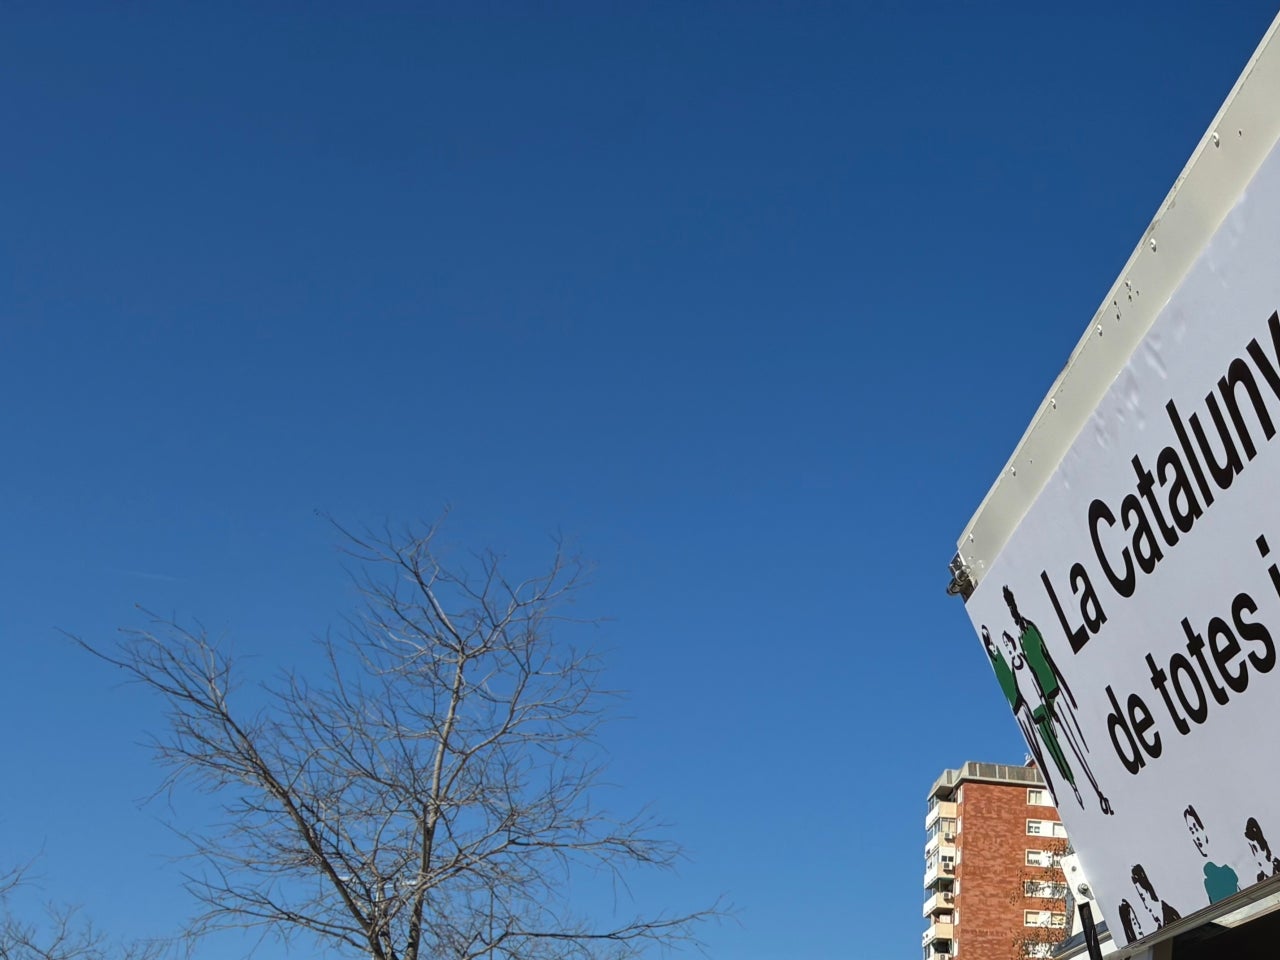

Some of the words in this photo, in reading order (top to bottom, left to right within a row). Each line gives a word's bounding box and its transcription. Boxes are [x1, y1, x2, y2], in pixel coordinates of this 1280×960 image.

[1041, 563, 1107, 654] La
[1106, 685, 1163, 775] de
[1145, 592, 1277, 735] totes
